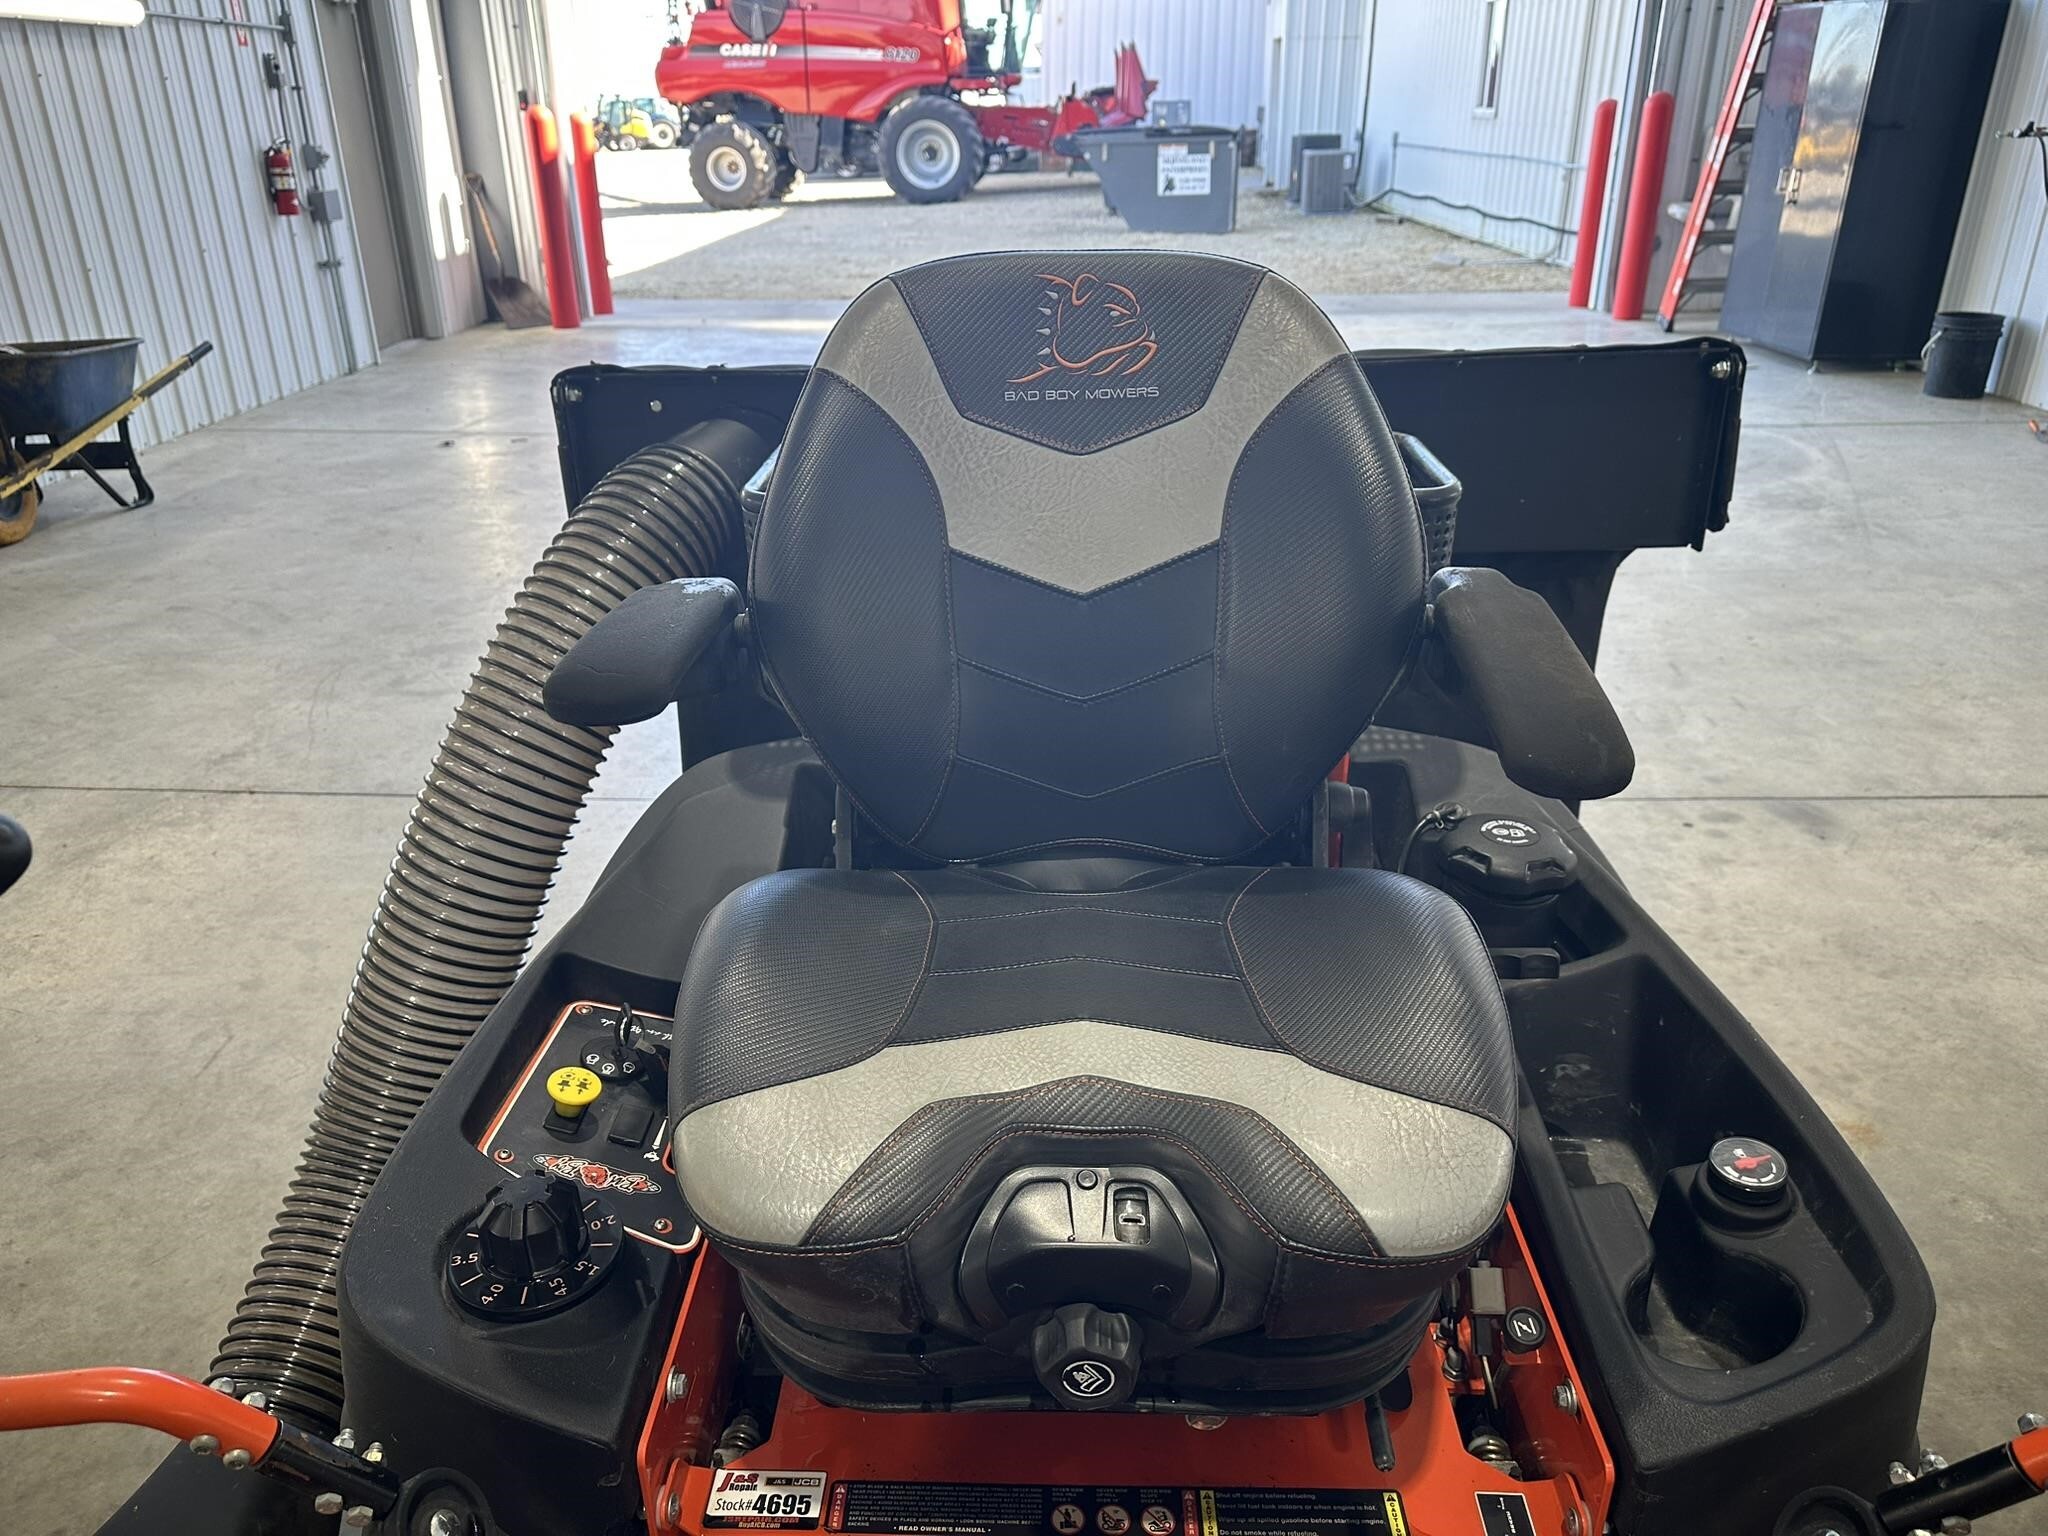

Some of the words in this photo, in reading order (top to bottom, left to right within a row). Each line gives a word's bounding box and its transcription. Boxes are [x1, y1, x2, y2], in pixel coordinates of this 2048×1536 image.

[719, 43, 763, 57] CASE
[1004, 390, 1040, 401] BAD
[1045, 389, 1080, 401] BOY
[1085, 386, 1160, 400] MOWERS
[590, 1214, 617, 1231] 2.0
[451, 1252, 479, 1266] 3.5
[574, 1260, 600, 1276] 1.5
[481, 1284, 504, 1305] 4.0
[548, 1277, 568, 1297] 4.5
[717, 1472, 759, 1492] J&S
[729, 1483, 758, 1491] Repair
[832, 1493, 844, 1528] DANGER
